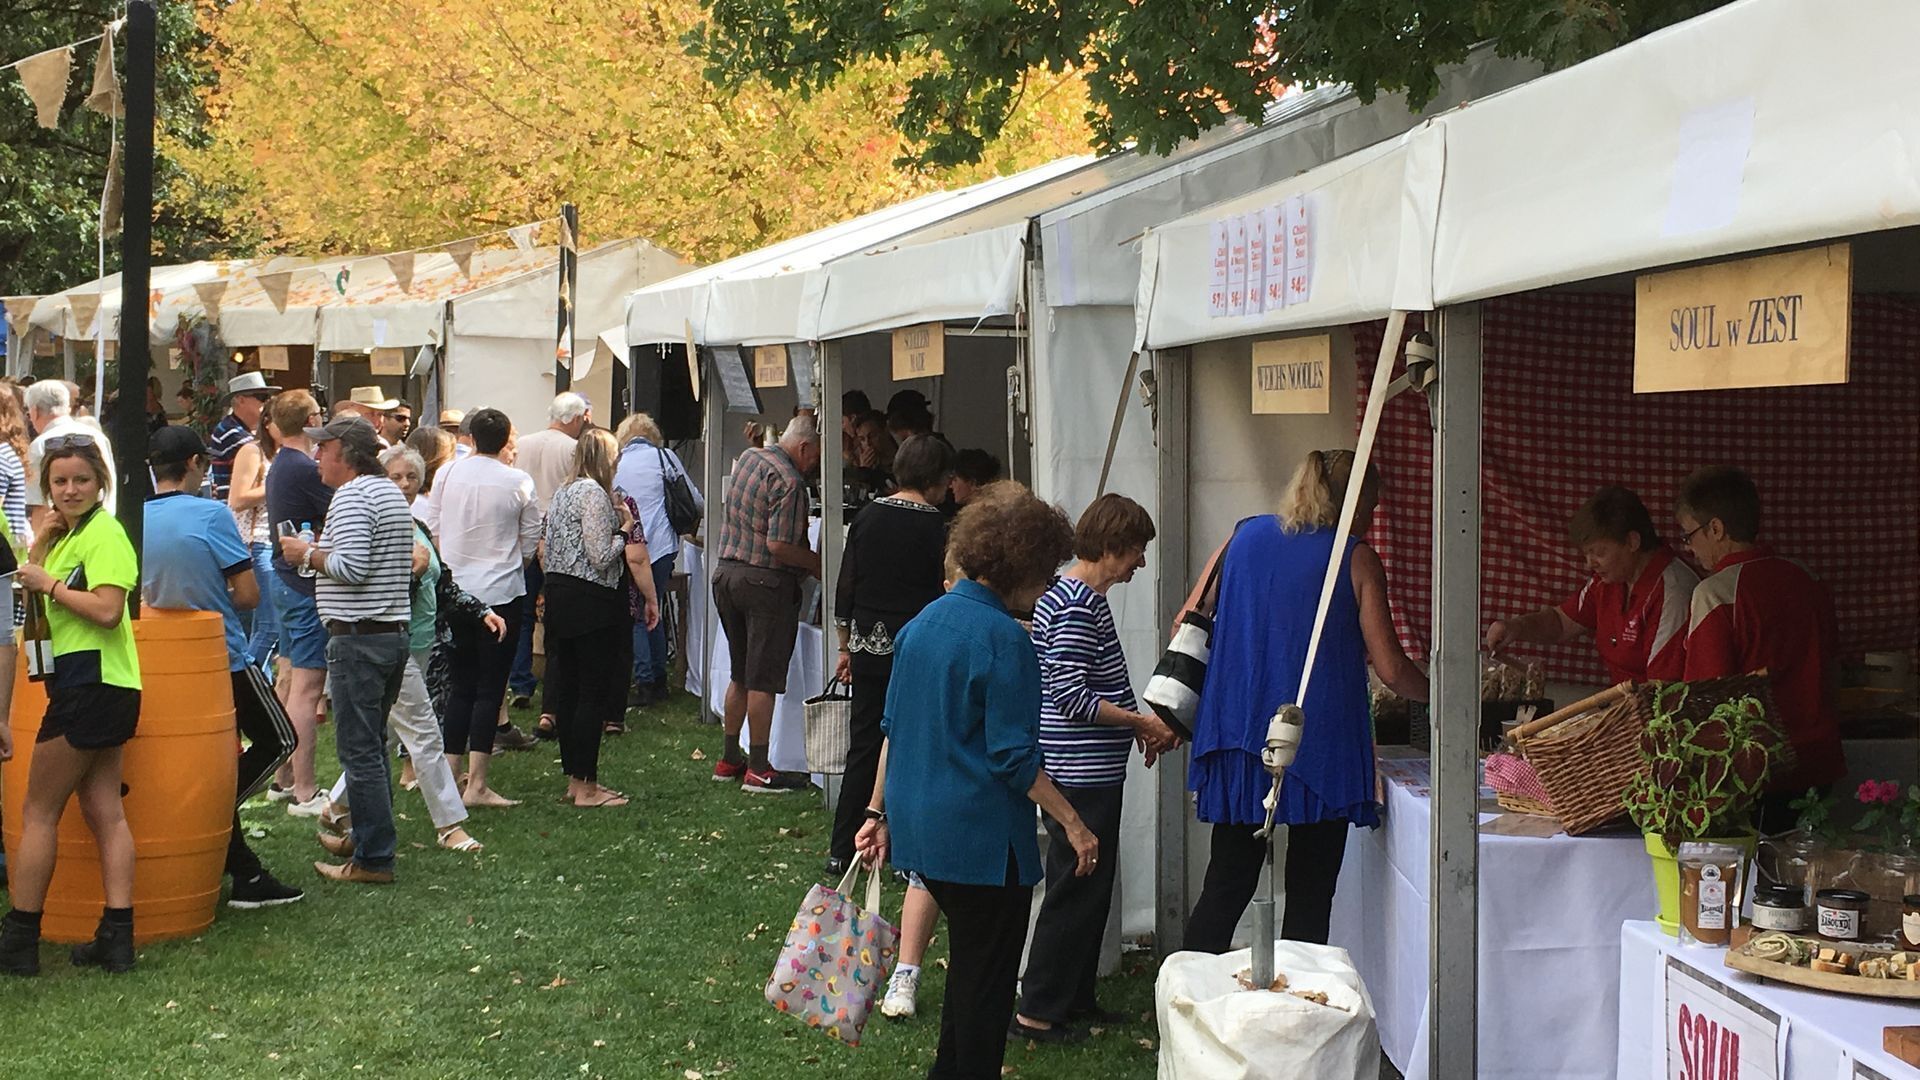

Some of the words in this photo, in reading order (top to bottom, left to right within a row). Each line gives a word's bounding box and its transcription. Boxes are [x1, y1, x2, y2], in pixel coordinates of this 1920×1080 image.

[1669, 304, 1720, 352] SOUL
[1726, 318, 1742, 347] w
[1746, 294, 1803, 345] ZEST
[1288, 360, 1324, 390] NOODLES
